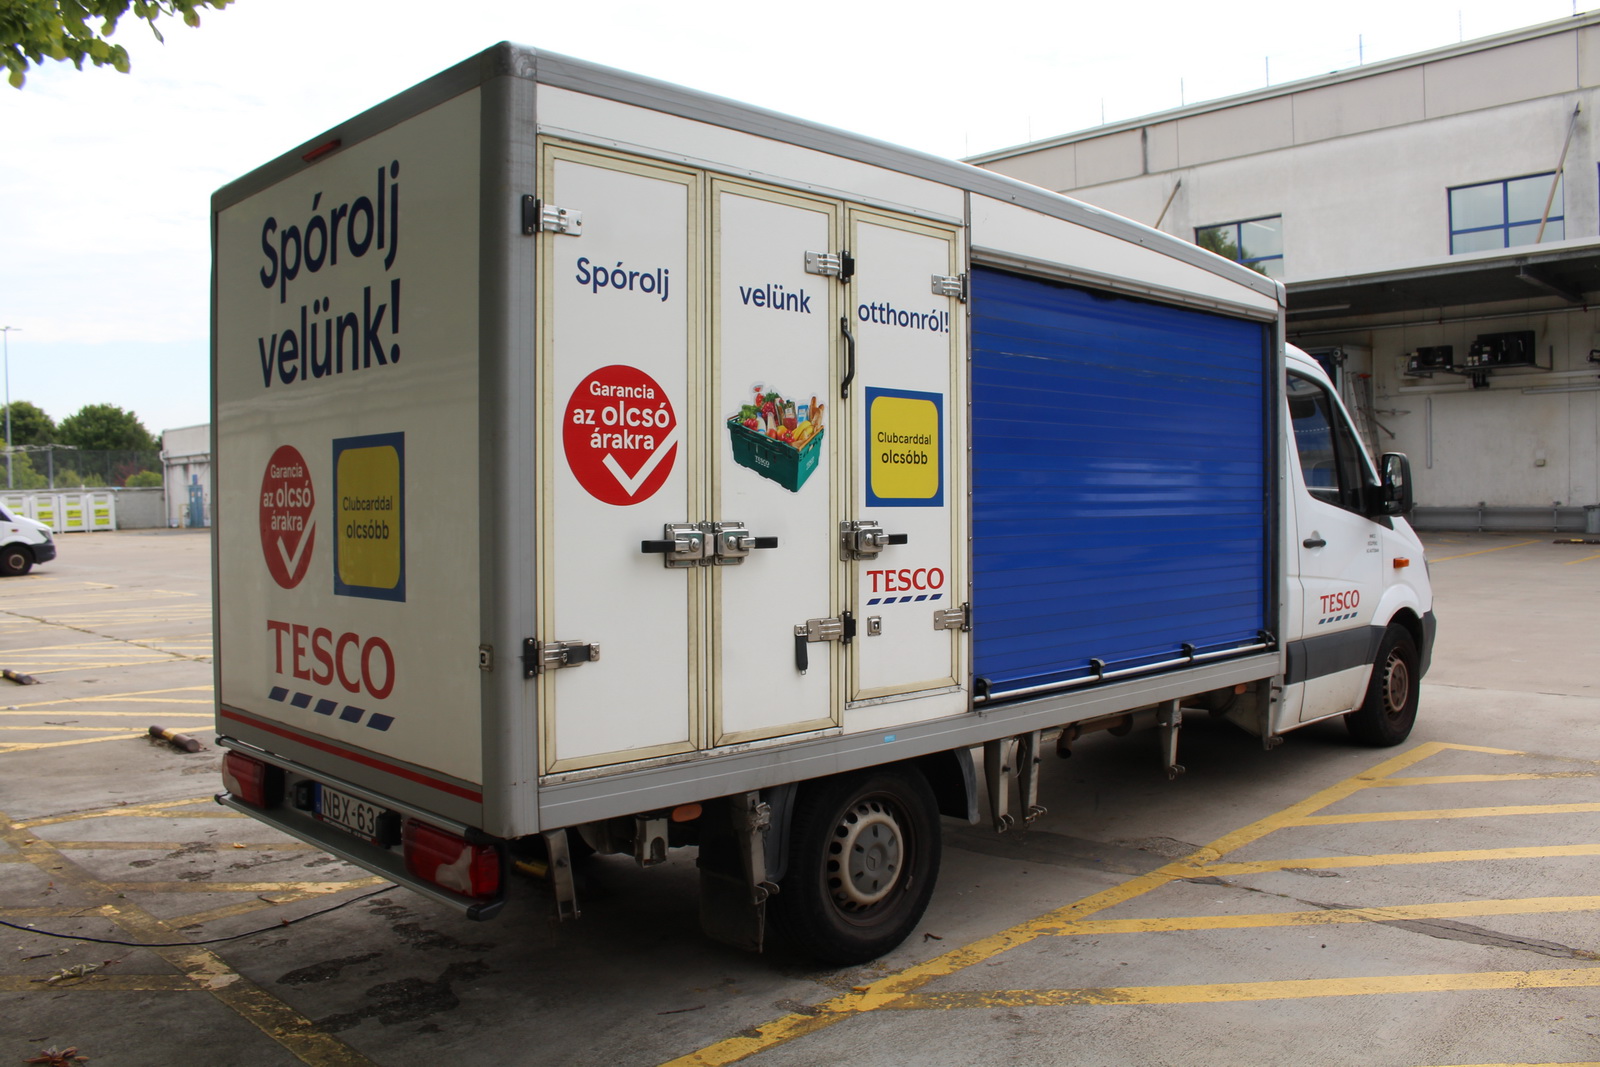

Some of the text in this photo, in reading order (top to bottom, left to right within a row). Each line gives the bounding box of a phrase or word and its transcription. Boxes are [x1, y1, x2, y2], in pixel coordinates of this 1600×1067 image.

[260, 159, 399, 304] Spórolj
[575, 257, 949, 333] Spórolj velünk otthonról!
[258, 278, 400, 388] velünk!
[589, 381, 655, 399] Garancia
[573, 400, 670, 428] az olcsó
[590, 428, 655, 450] árakra
[877, 431, 931, 445] Clubcarddal
[881, 449, 928, 465] olcsóbb
[270, 462, 303, 478] Garancia
[263, 480, 311, 508] az olcsó
[343, 495, 393, 511] Clubcarddal
[271, 510, 303, 531] árakra
[346, 519, 390, 539] olcsóbb
[866, 567, 944, 593] TESCO
[1320, 589, 1360, 614] TESCO
[267, 619, 395, 700] TESCO
[323, 788, 382, 834] NBX-63
